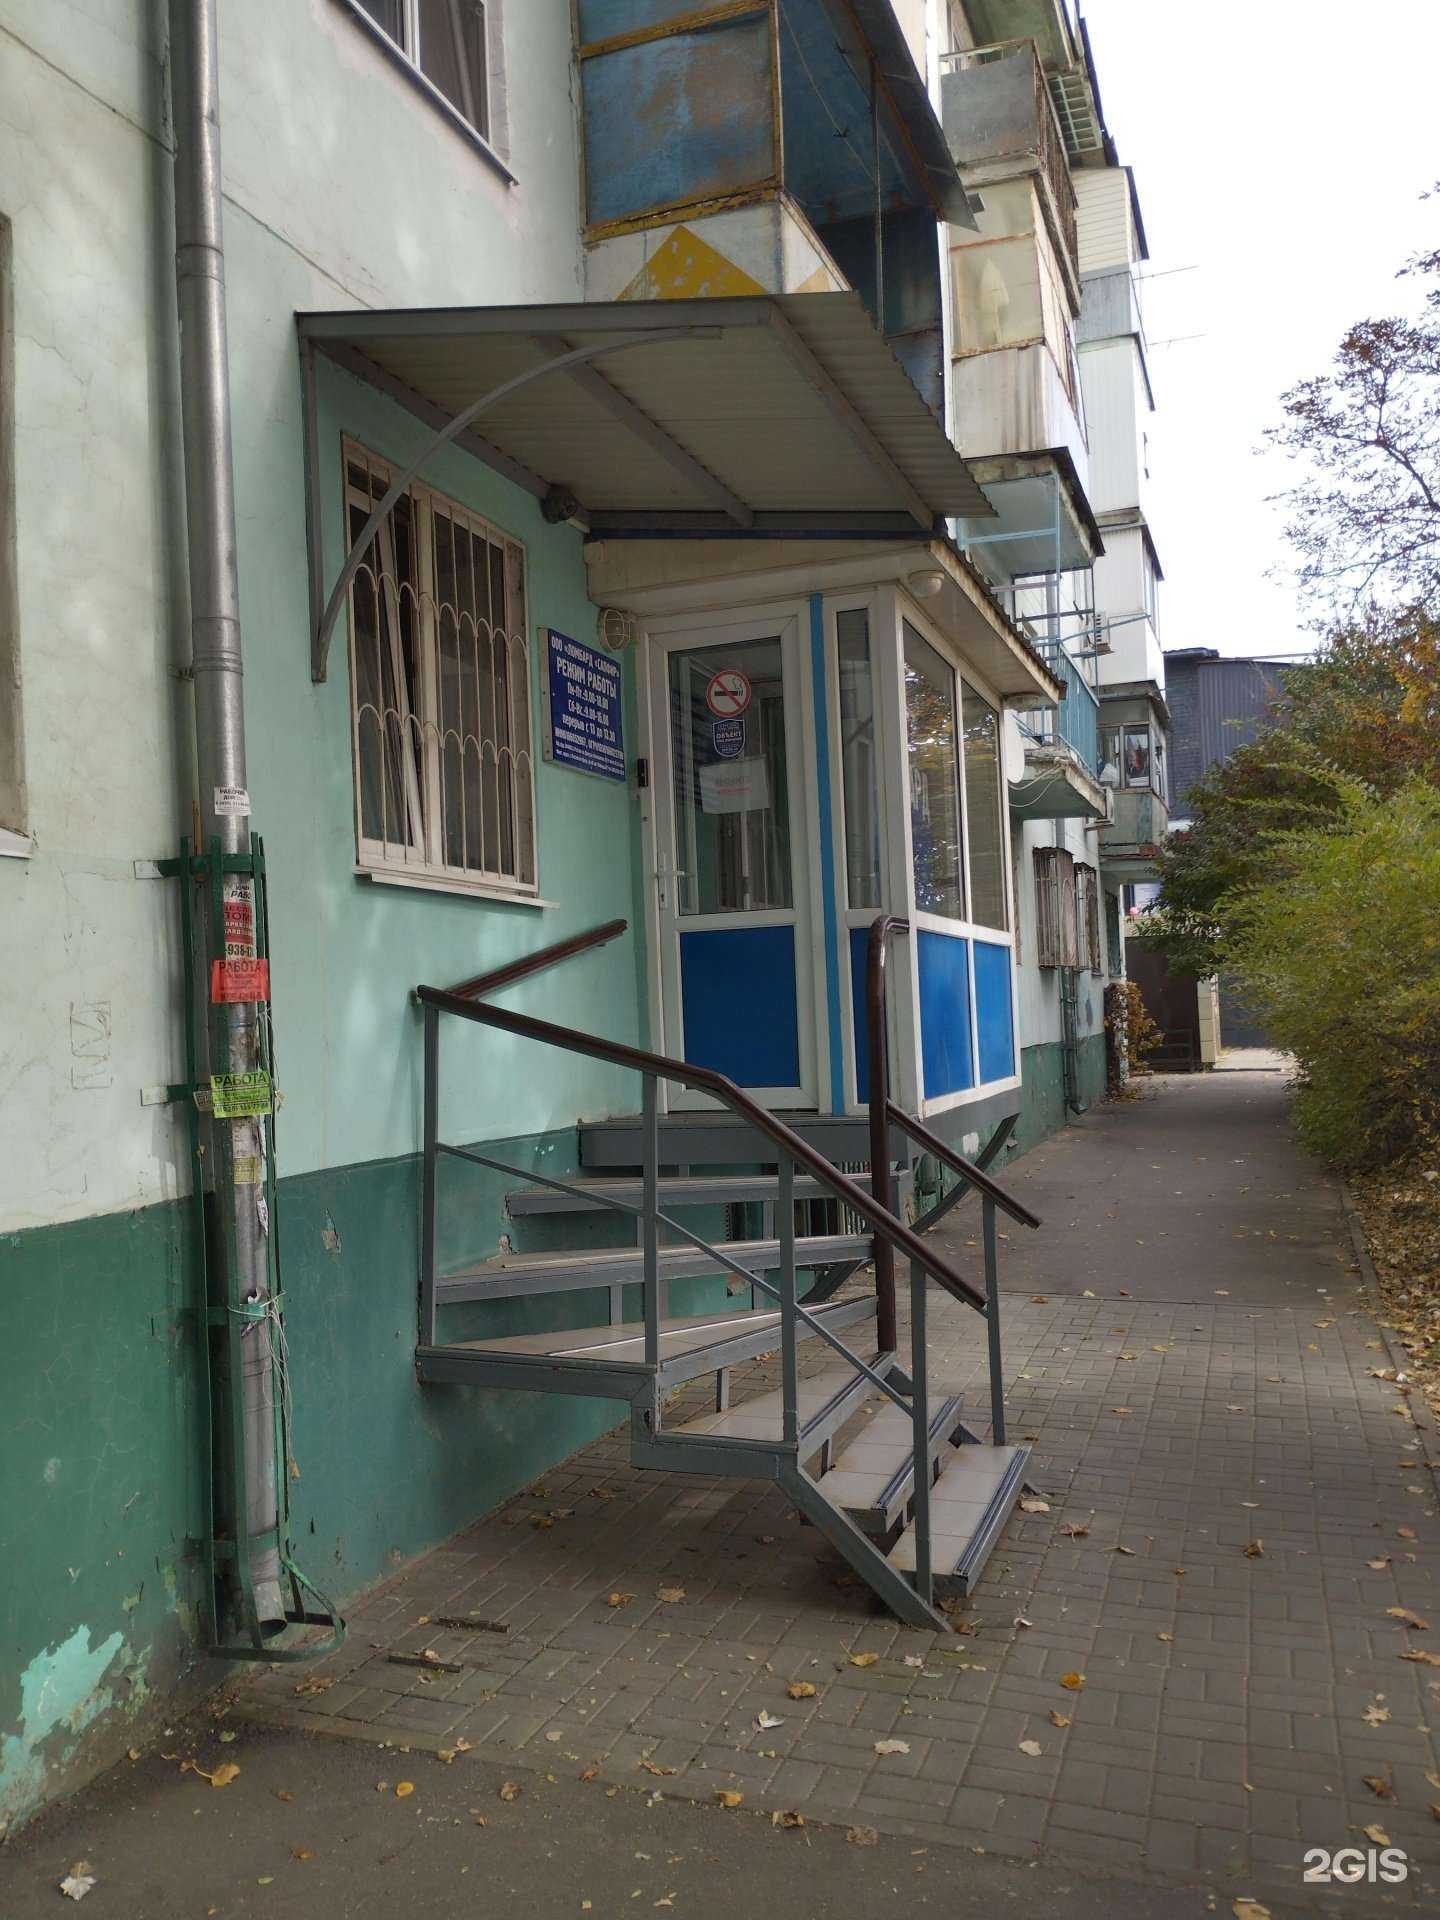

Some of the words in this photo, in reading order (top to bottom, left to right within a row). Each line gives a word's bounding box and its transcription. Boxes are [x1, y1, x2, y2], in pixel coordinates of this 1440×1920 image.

[551, 636, 563, 652] ООО
[556, 656, 586, 685] РЕЖИМ
[587, 670, 617, 700] РАБОТЫ
[219, 961, 261, 973] РАБОТА
[214, 1072, 267, 1087] РАБОТА
